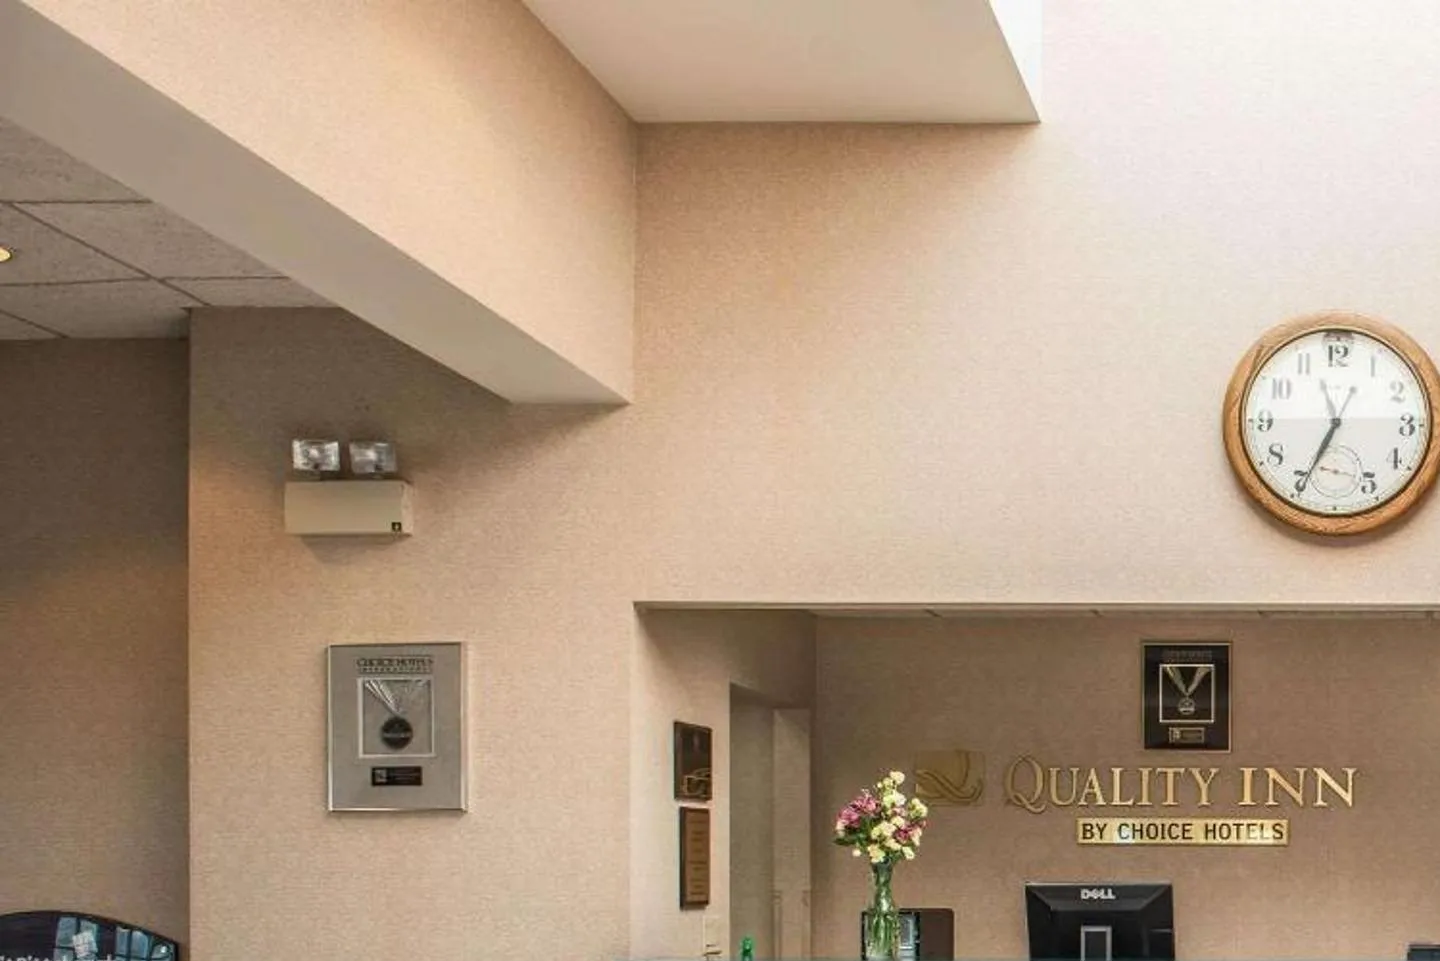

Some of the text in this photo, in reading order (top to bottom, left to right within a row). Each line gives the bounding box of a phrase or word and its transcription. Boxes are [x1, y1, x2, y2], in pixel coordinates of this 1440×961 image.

[1297, 353, 1310, 376] 11
[1328, 344, 1349, 367] 12
[1272, 378, 1292, 400] 10
[1389, 381, 1405, 404] 2
[1257, 409, 1274, 433] 9
[1399, 413, 1416, 437] 3
[1267, 444, 1284, 466] 8
[1387, 447, 1403, 470] 4
[1360, 472, 1377, 495] 5
[1006, 756, 1357, 813] QUALITY INN
[1082, 823, 1284, 840] BY CHOICE HOTELS
[1080, 888, 1116, 900] DELL
